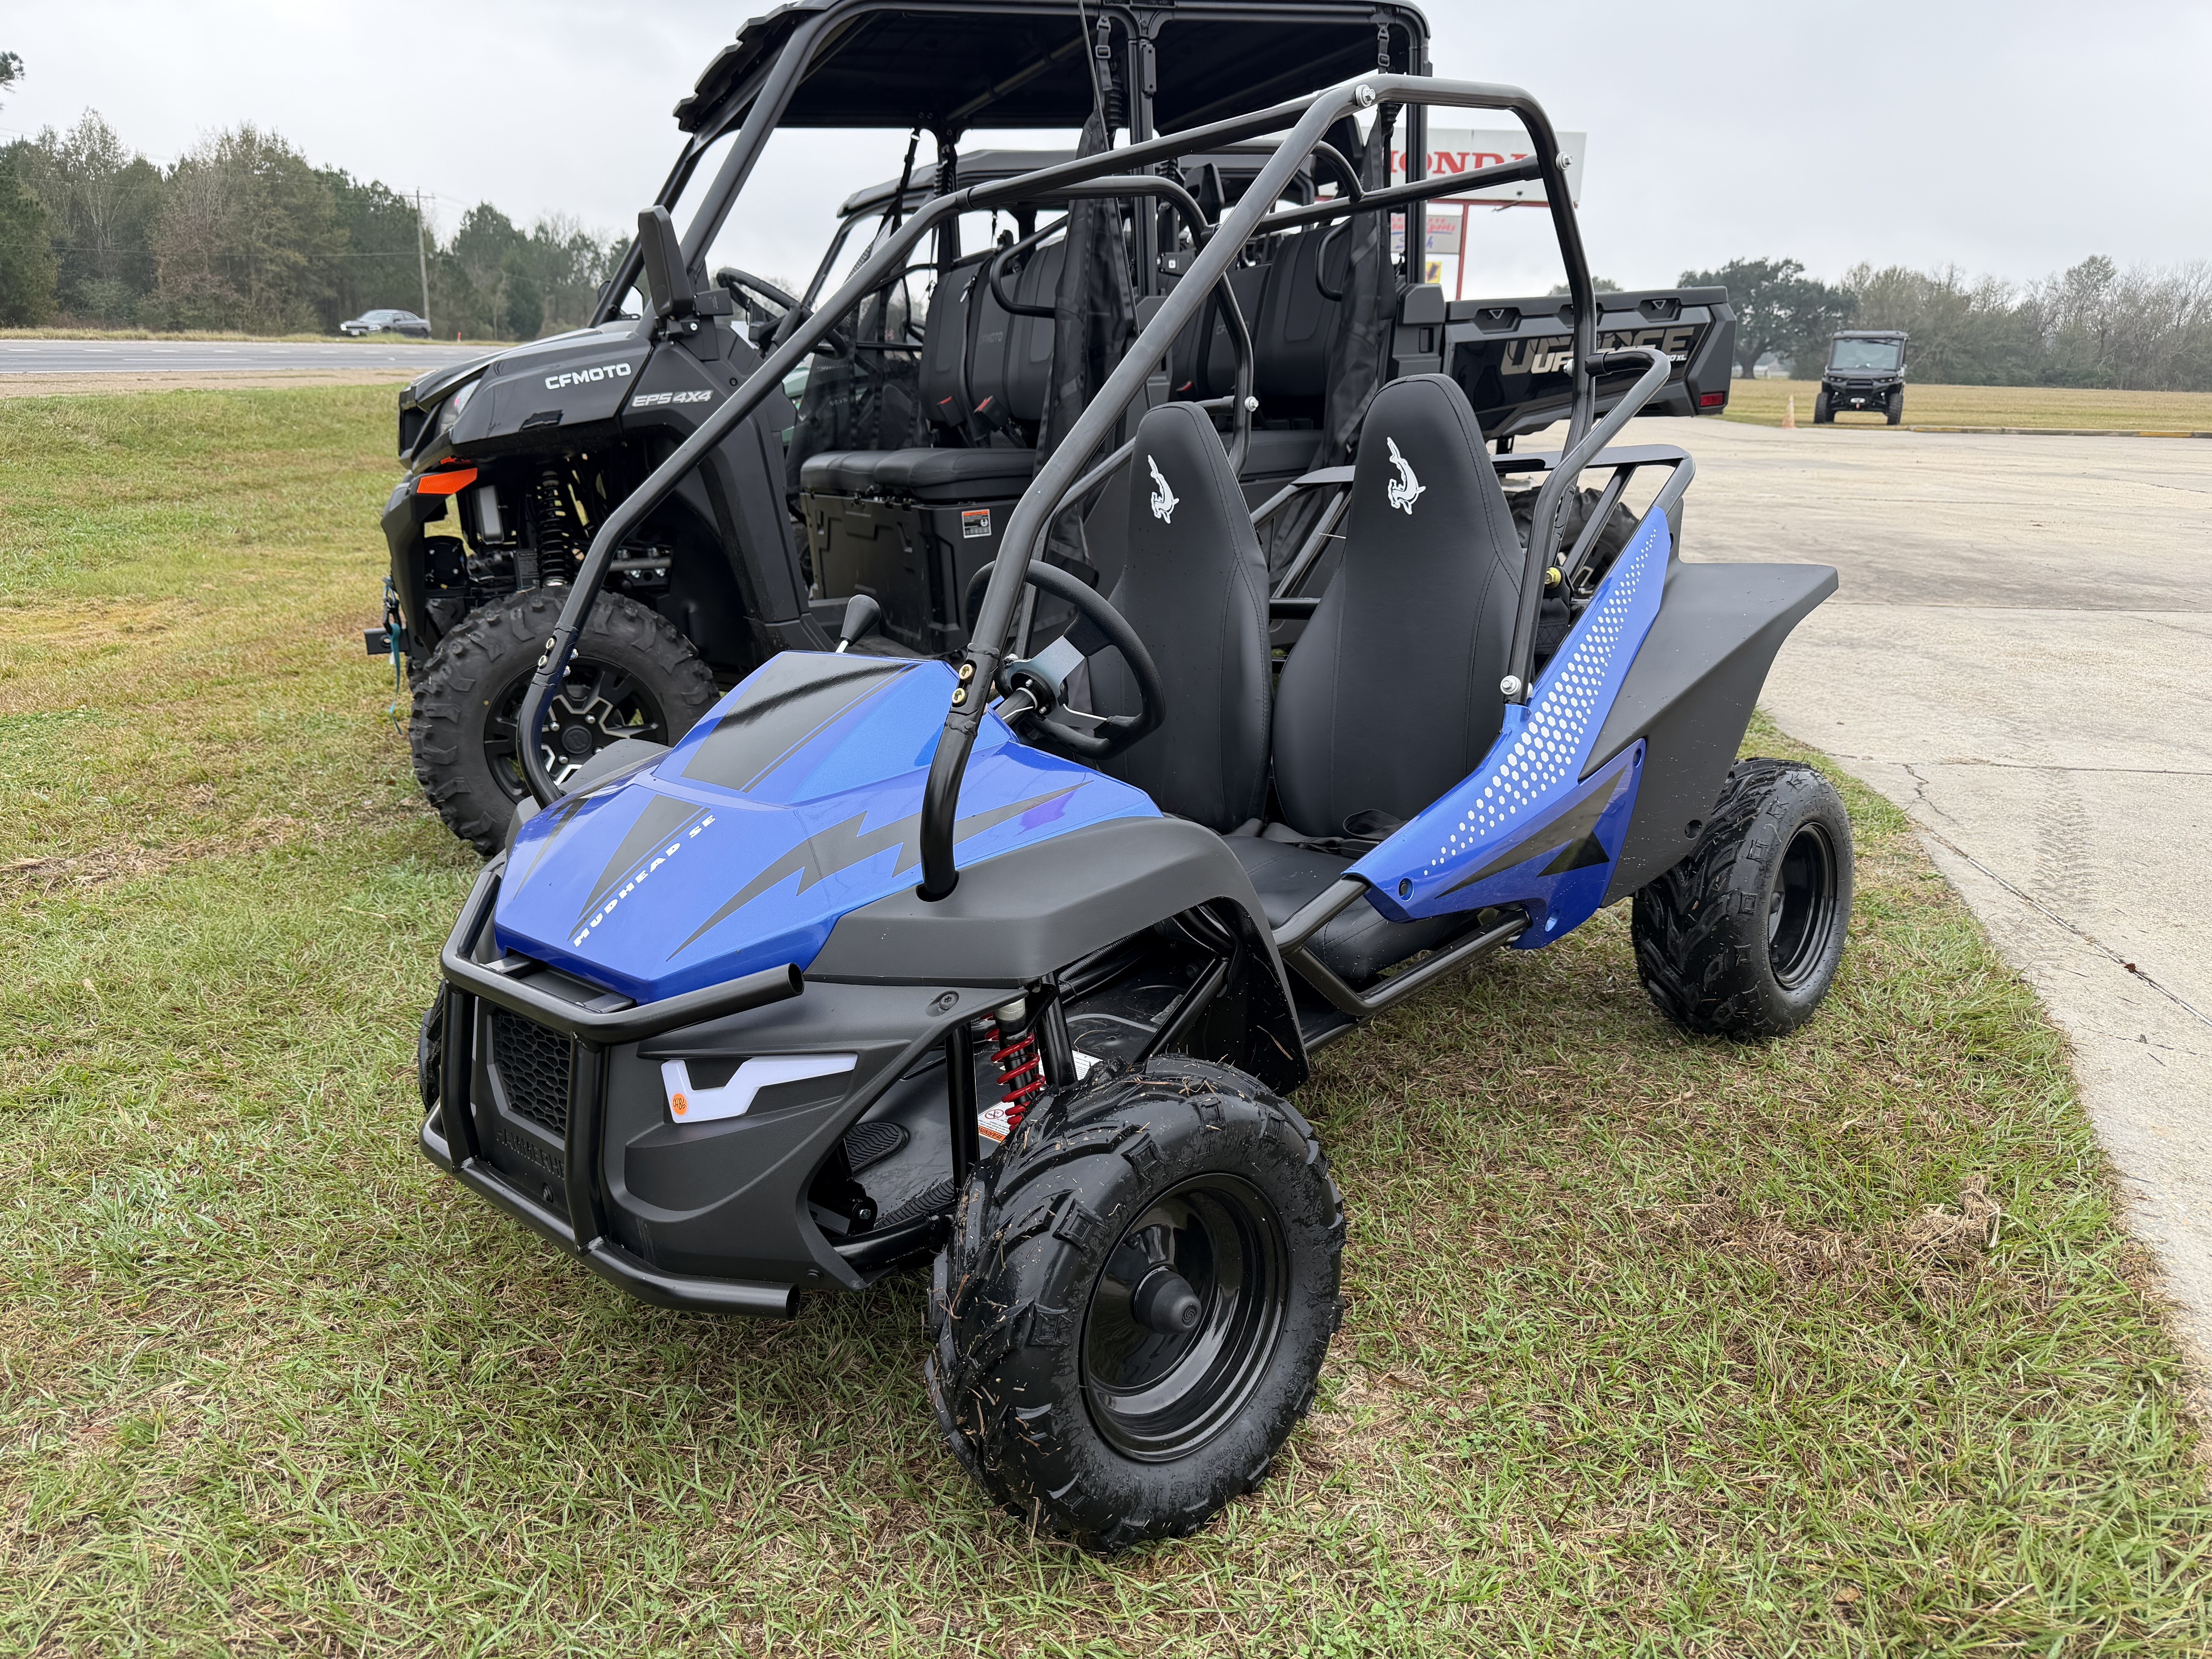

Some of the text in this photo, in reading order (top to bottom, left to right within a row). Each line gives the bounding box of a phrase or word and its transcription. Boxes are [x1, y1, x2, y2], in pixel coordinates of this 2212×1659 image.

[545, 362, 632, 390] CFMOTO
[632, 390, 713, 407] EPS 4X4
[574, 815, 716, 947] MUDHEAD SE
